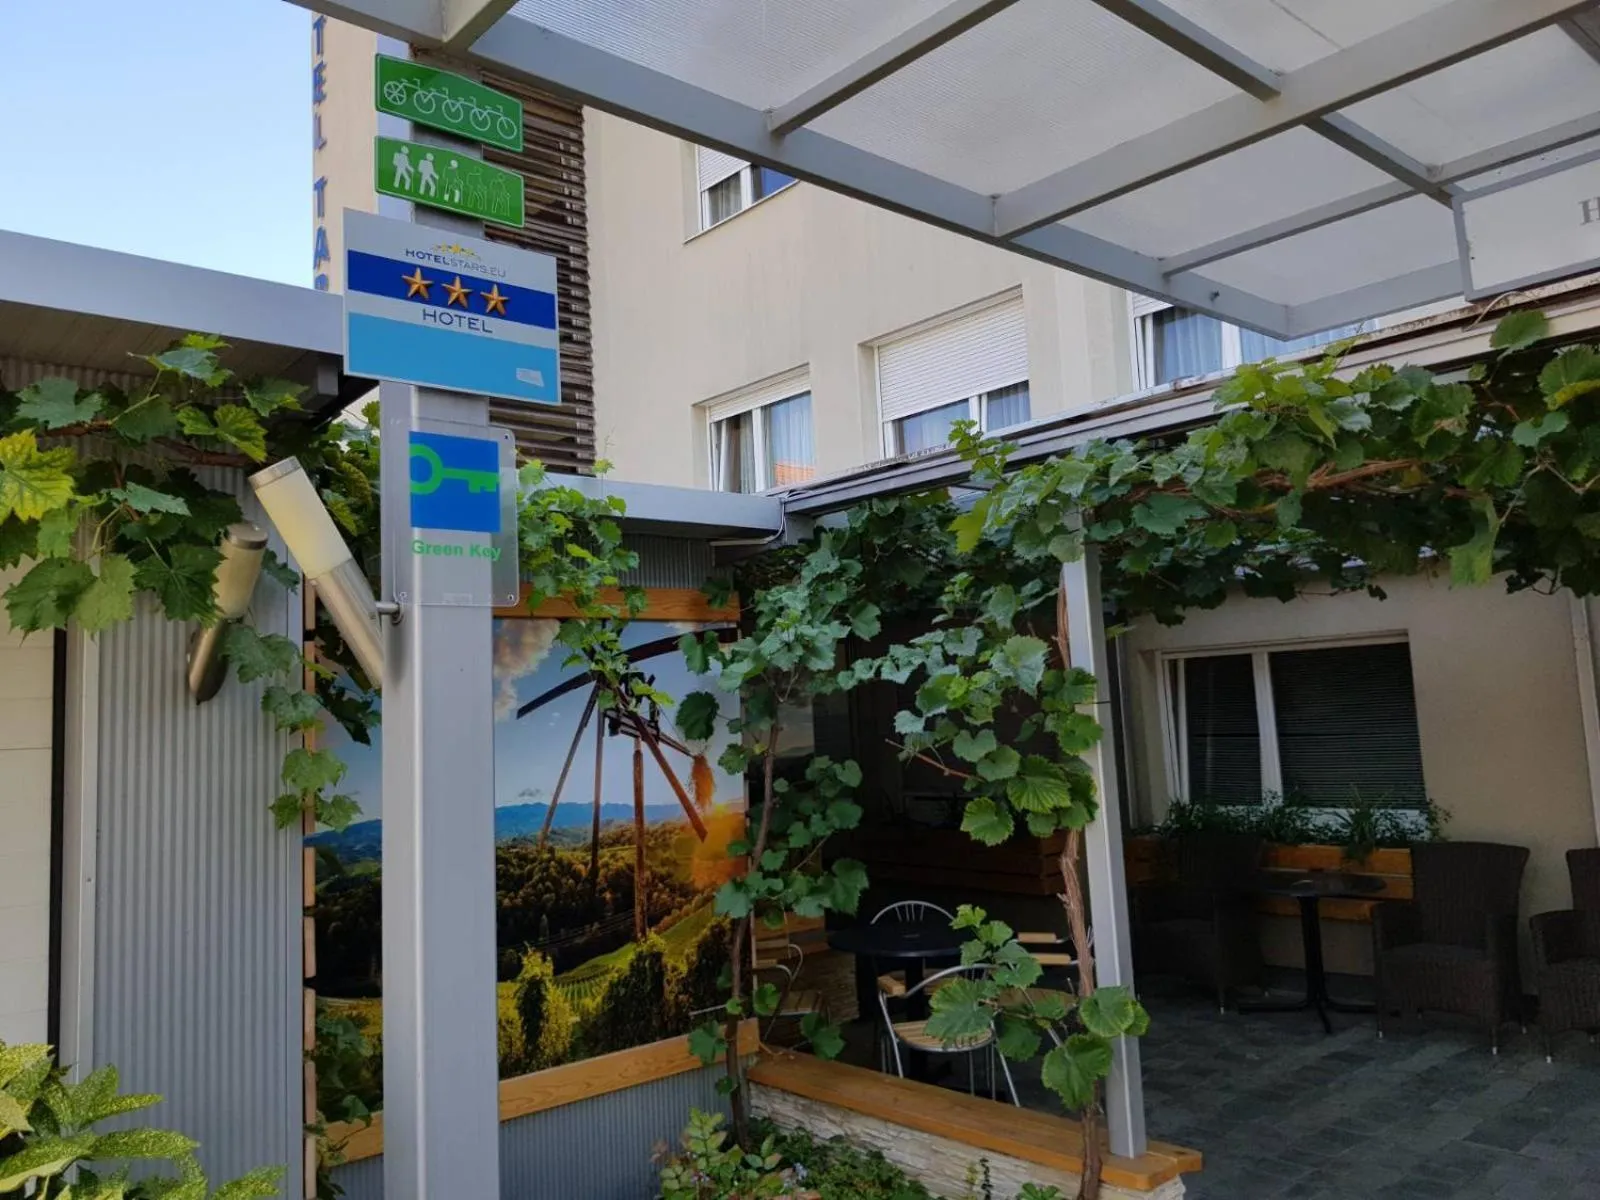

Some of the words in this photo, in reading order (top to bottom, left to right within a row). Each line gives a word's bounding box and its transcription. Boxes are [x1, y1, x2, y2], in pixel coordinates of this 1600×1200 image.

[405, 248, 506, 277] HOTELSTARS.EU
[422, 308, 493, 334] HOTEL
[411, 539, 463, 557] Green
[469, 543, 502, 562] Key
